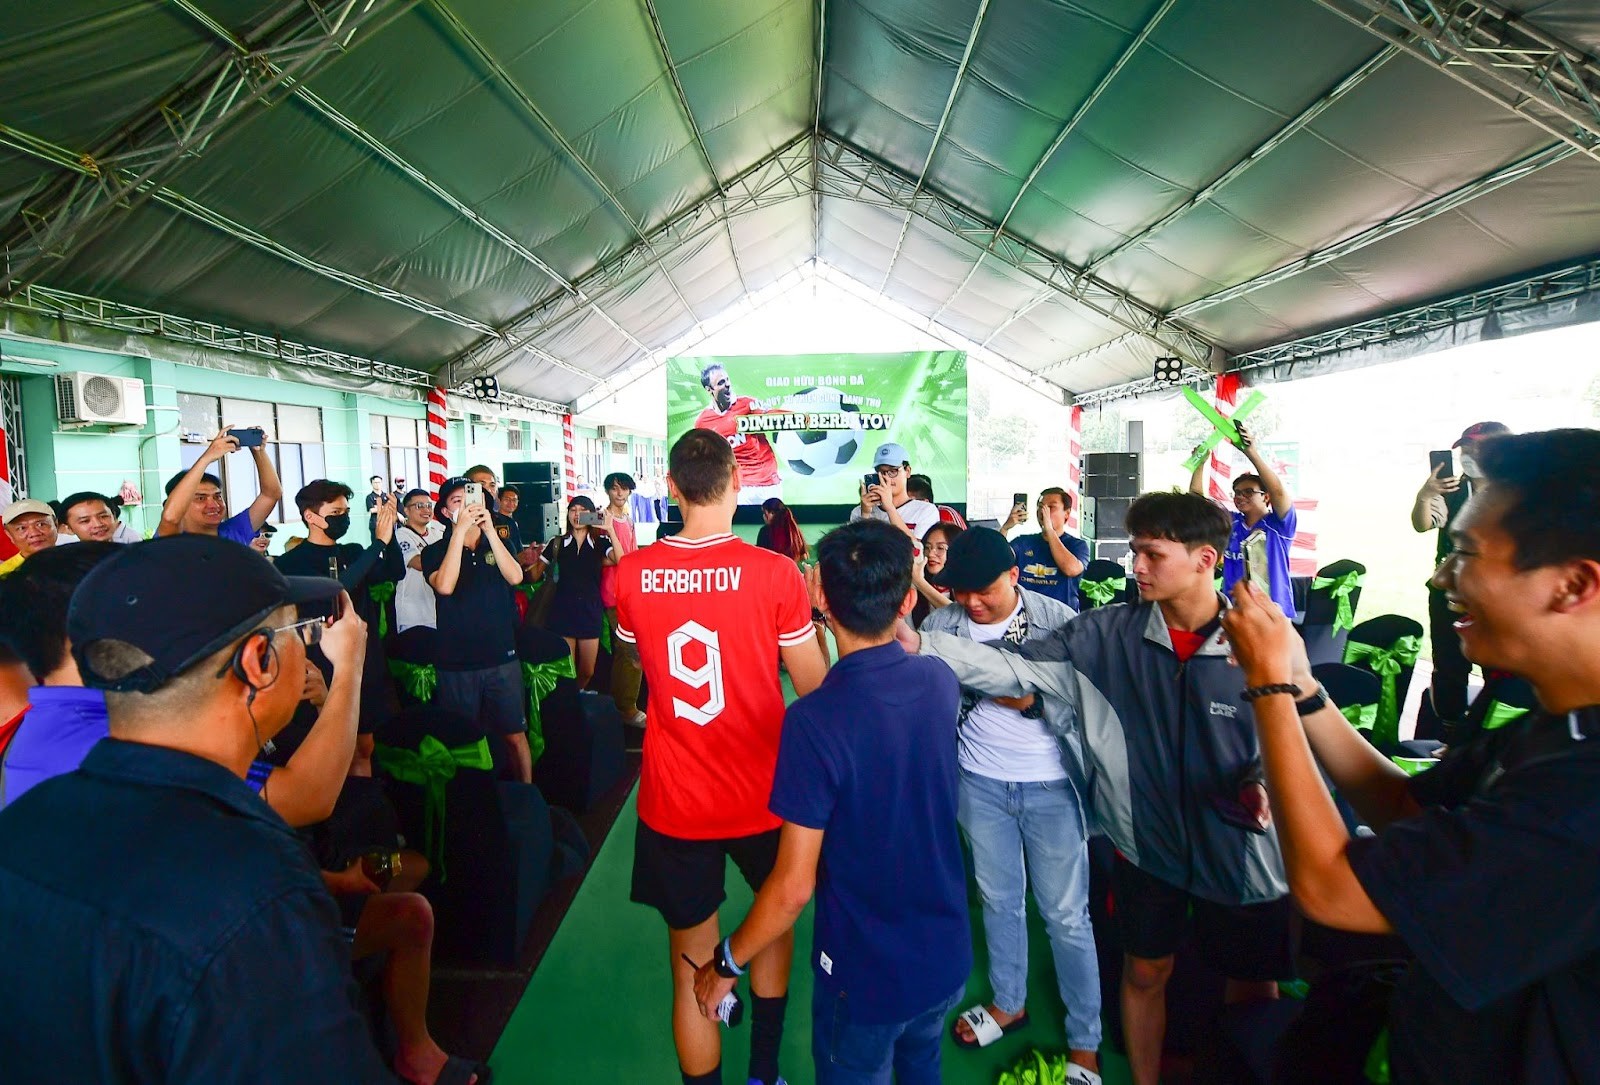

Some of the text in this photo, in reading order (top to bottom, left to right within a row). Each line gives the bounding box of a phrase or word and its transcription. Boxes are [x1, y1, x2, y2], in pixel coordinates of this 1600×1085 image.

[765, 376, 790, 387] GIAO
[736, 413, 806, 432] DIMITAR
[726, 432, 747, 449] ON
[641, 566, 742, 594] BERBATOV
[666, 619, 726, 727] 9
